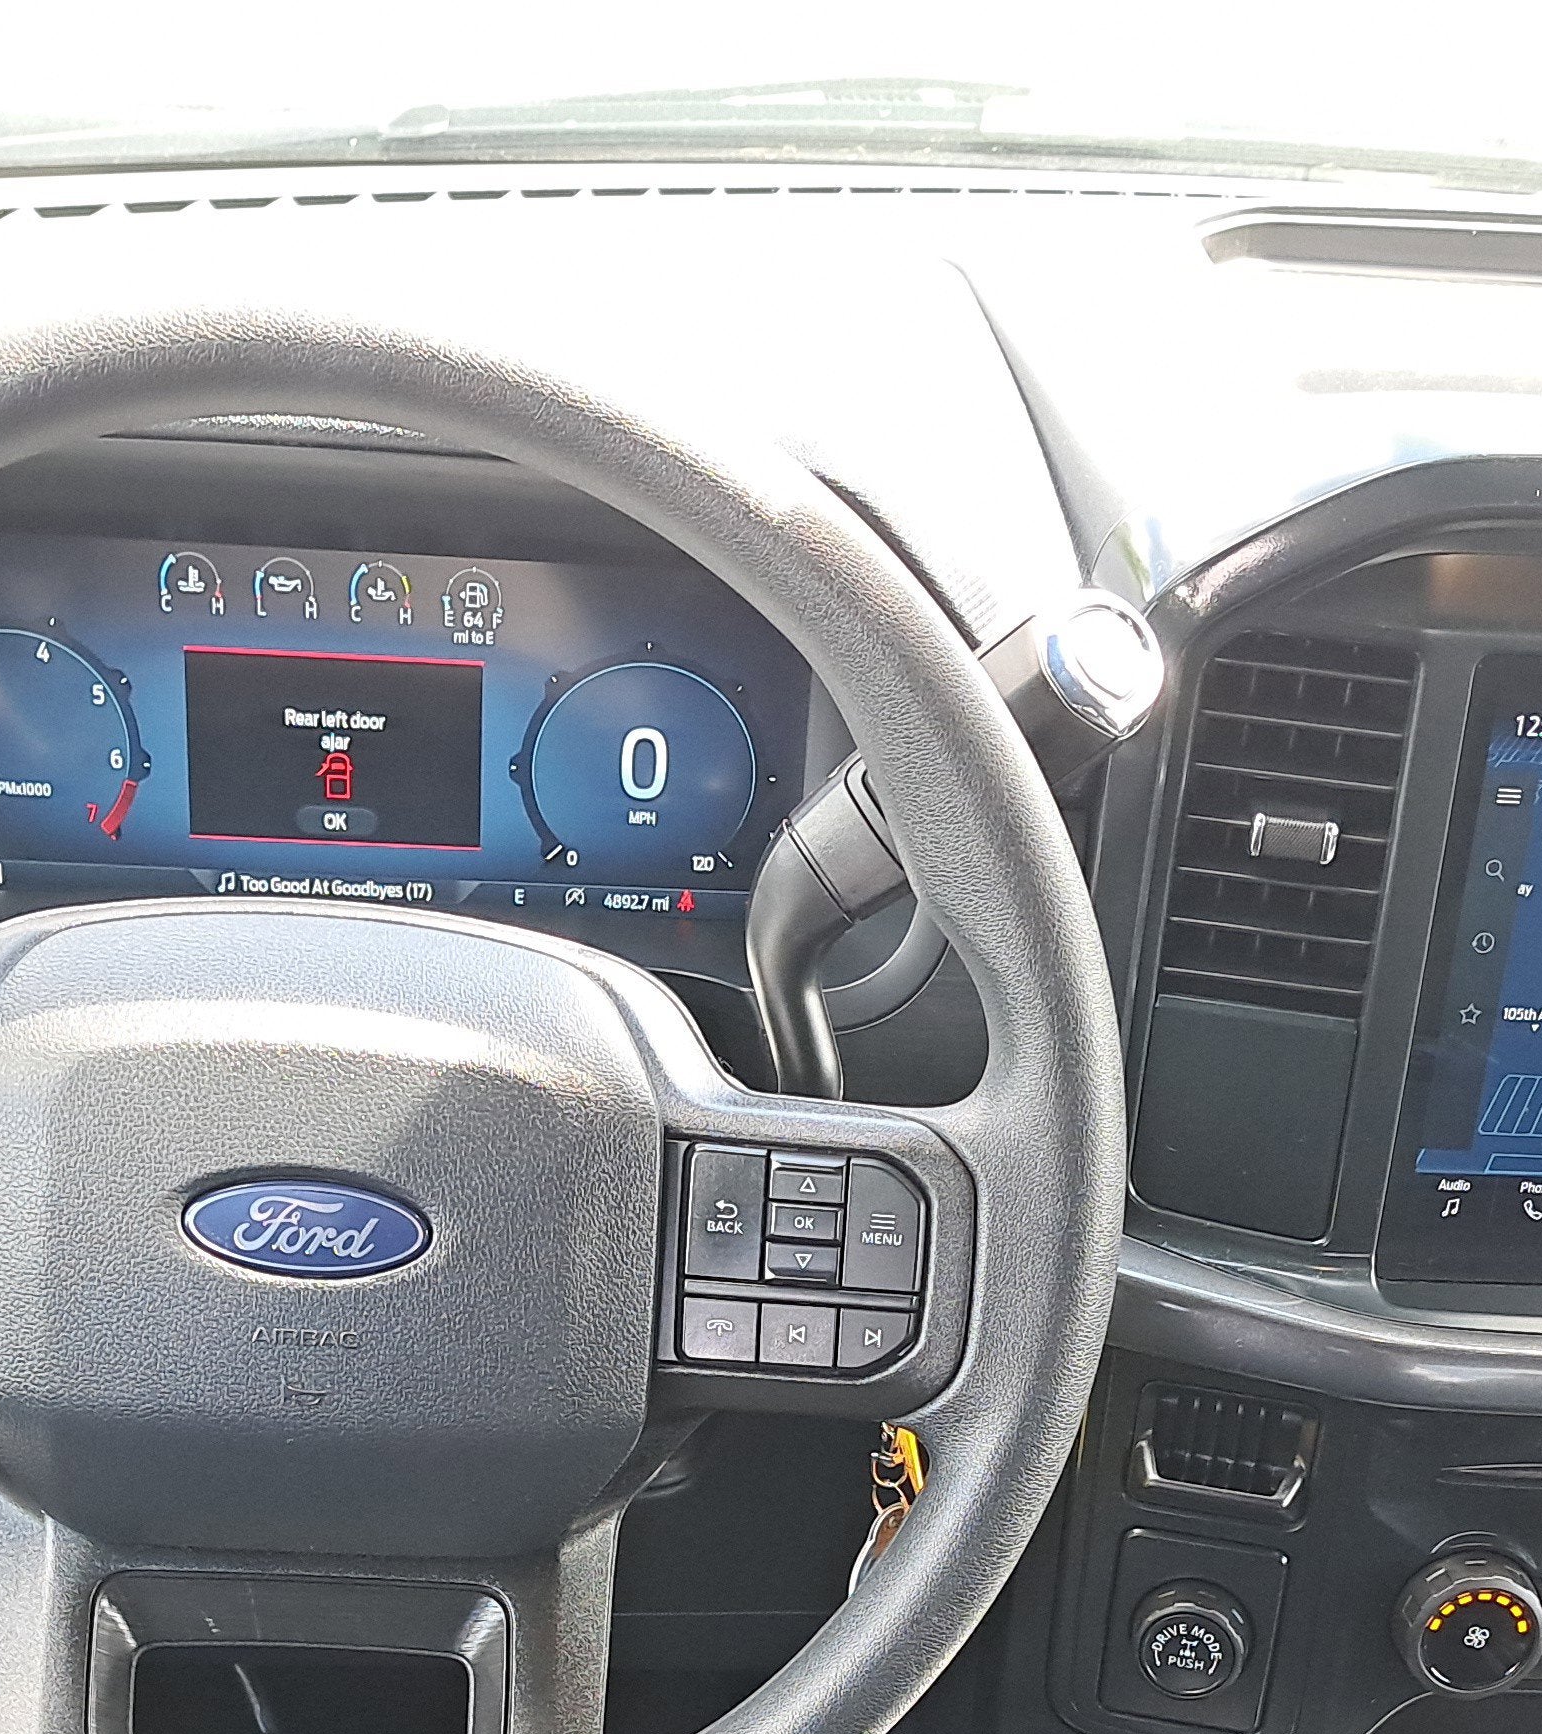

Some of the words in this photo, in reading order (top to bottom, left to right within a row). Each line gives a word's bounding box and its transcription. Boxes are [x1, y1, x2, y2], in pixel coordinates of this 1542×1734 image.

[161, 595, 172, 612] C
[212, 597, 225, 615] H
[305, 600, 318, 619] H
[350, 606, 362, 622] C
[399, 607, 412, 624] H
[445, 610, 455, 627] E
[463, 612, 484, 628] 64
[492, 613, 503, 629] F
[471, 632, 484, 644] to
[485, 632, 495, 645] E
[36, 642, 50, 663] 4
[92, 684, 105, 705] 5
[284, 708, 319, 727] Rear
[322, 711, 348, 729] left
[350, 711, 386, 731] door
[321, 732, 351, 752] ajar
[110, 749, 123, 770] 6
[621, 726, 670, 801] 0
[86, 803, 99, 823] 7
[323, 813, 348, 831] OK
[628, 810, 657, 826] MPH
[566, 851, 578, 866] 0
[692, 855, 714, 872] 120
[240, 875, 269, 892] Too
[270, 876, 309, 895] Good
[312, 878, 330, 896] At
[332, 880, 403, 901] Goodbyes
[406, 882, 433, 901] (17)
[514, 889, 525, 905] E
[604, 893, 649, 910] 4892.7
[652, 895, 670, 911] mi
[1503, 1007, 1536, 1022] 105th
[1438, 1179, 1471, 1192] Audio
[233, 1195, 380, 1259] Ford
[706, 1220, 744, 1235] BACK
[794, 1216, 815, 1230] OK
[861, 1232, 902, 1247] MENU
[1151, 1624, 1188, 1651] DRIVE
[1191, 1625, 1222, 1660] MODE
[1168, 1655, 1205, 1671] PUSH
